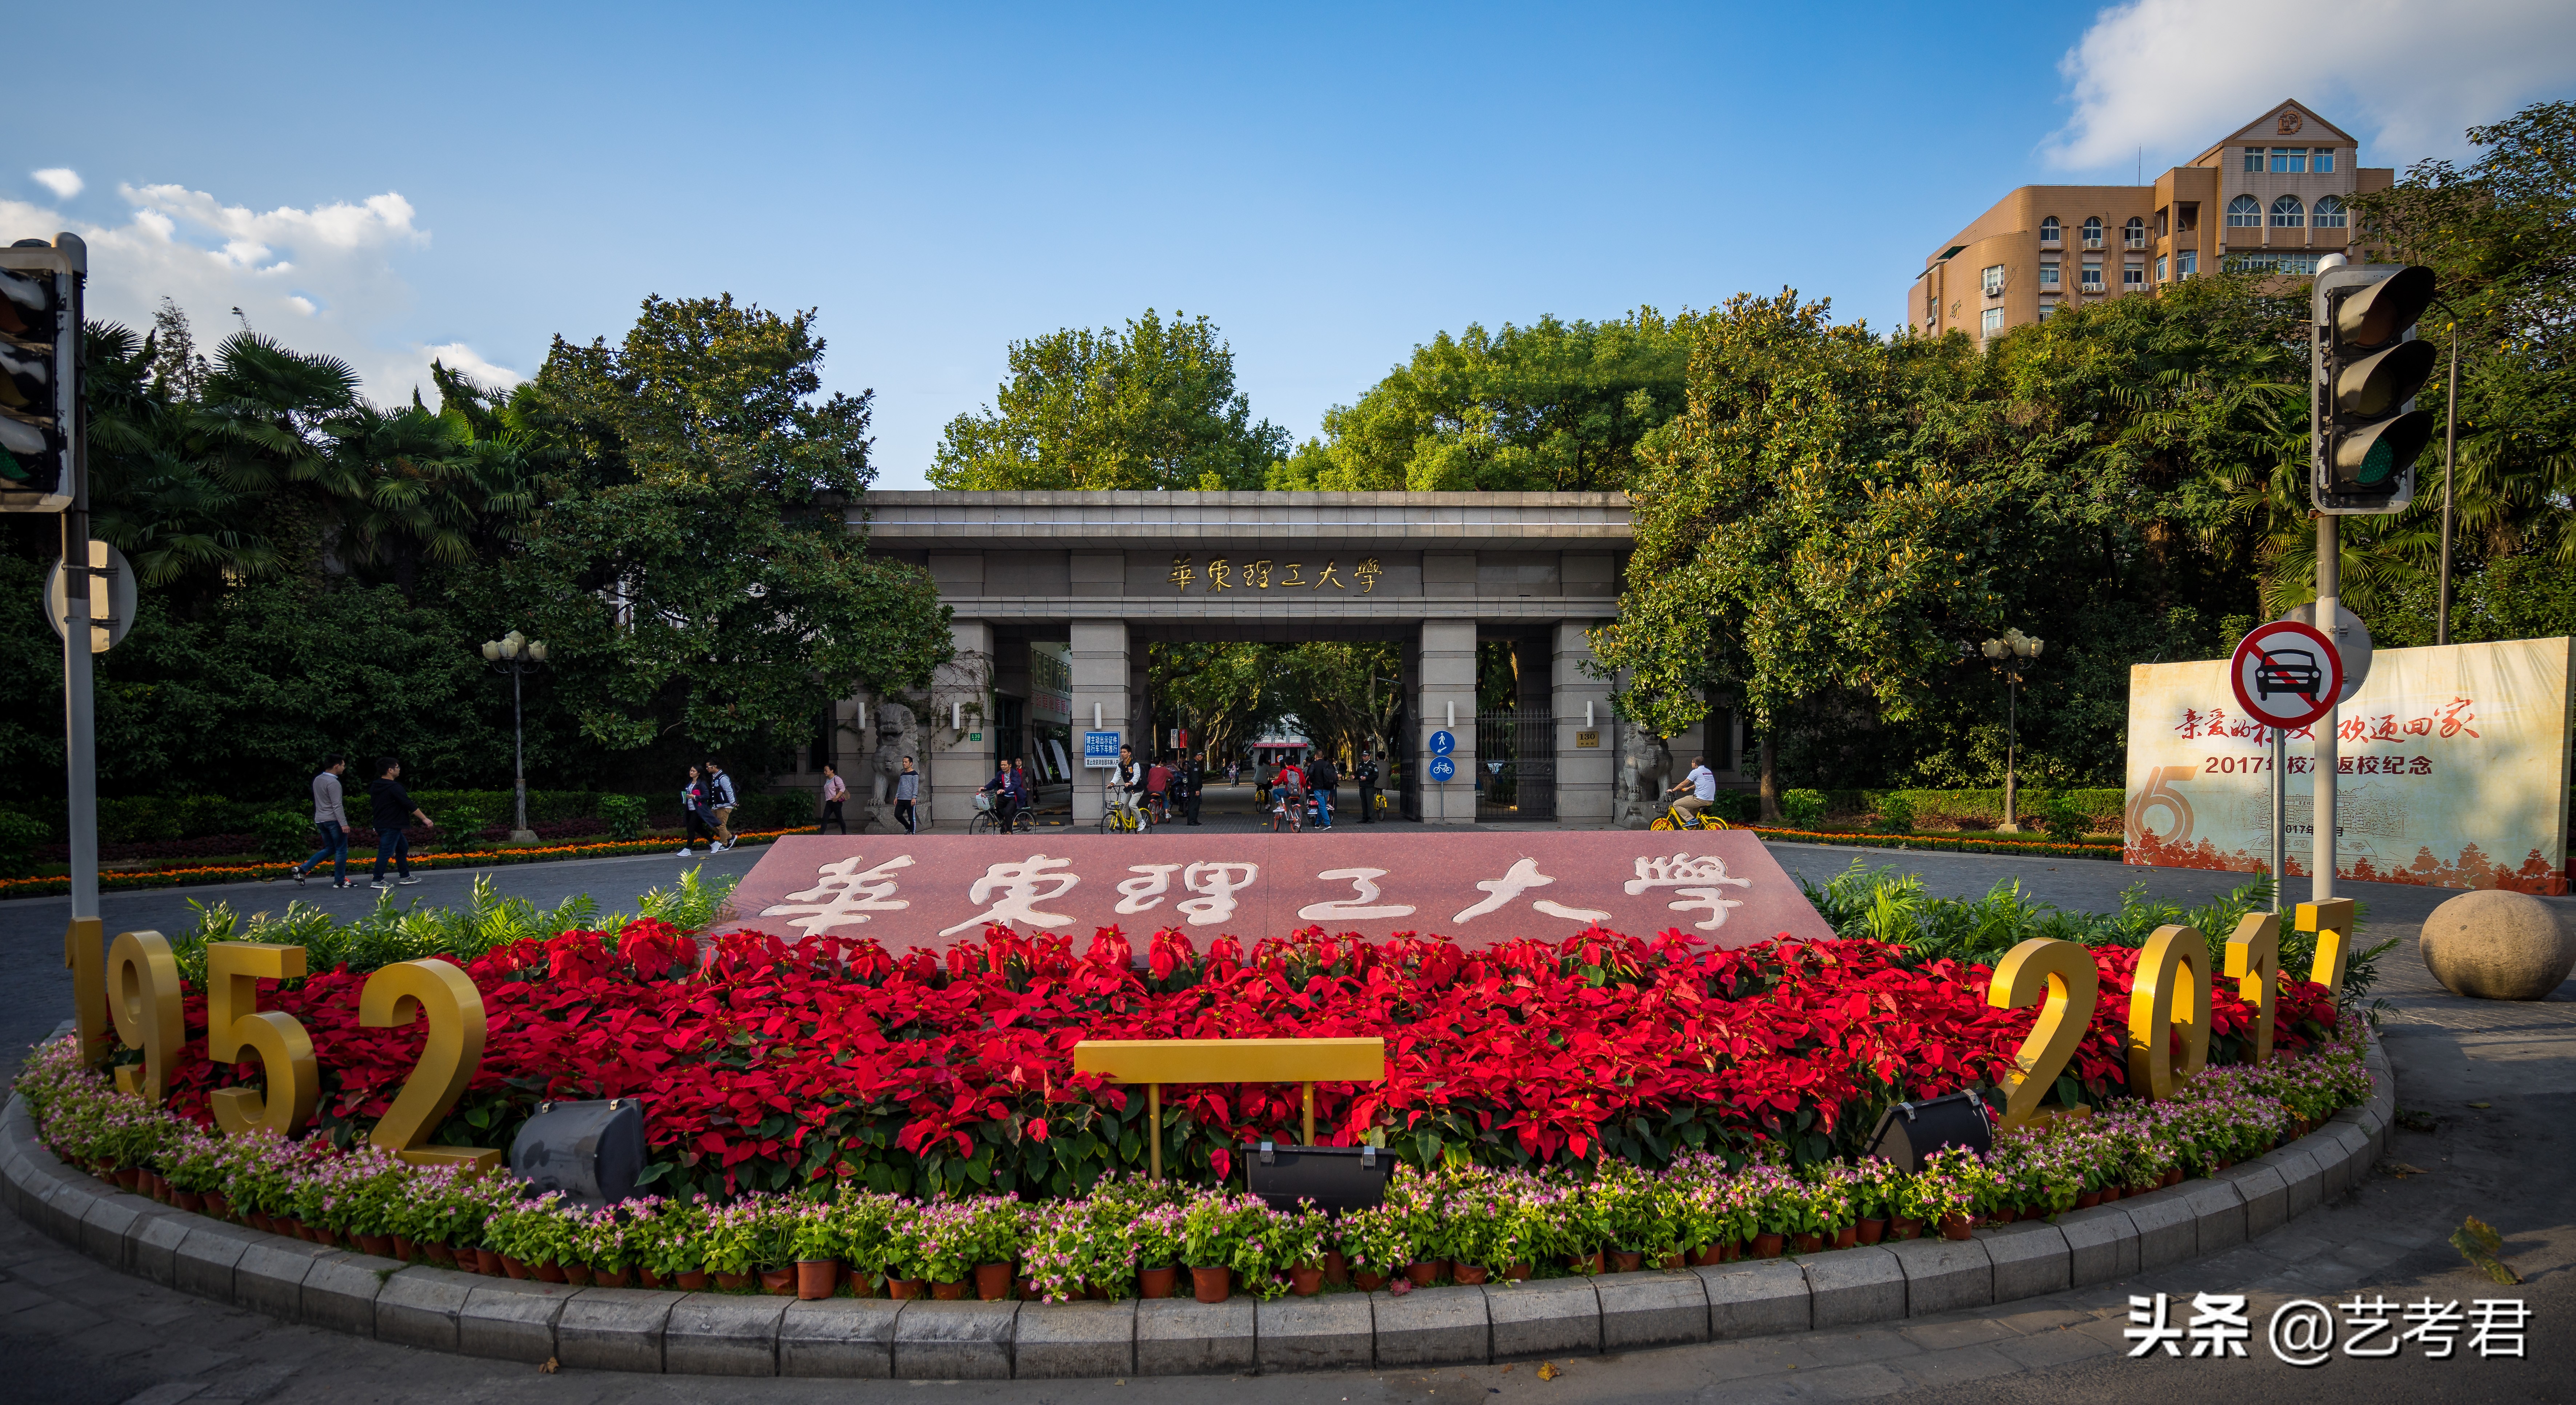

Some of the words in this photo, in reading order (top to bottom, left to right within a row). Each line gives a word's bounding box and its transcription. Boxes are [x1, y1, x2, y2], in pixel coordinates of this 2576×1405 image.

[1087, 736, 1117, 744] 请主动出示证件
[1087, 744, 1117, 753] 自行车下车推行
[1988, 898, 2354, 1134] 2017
